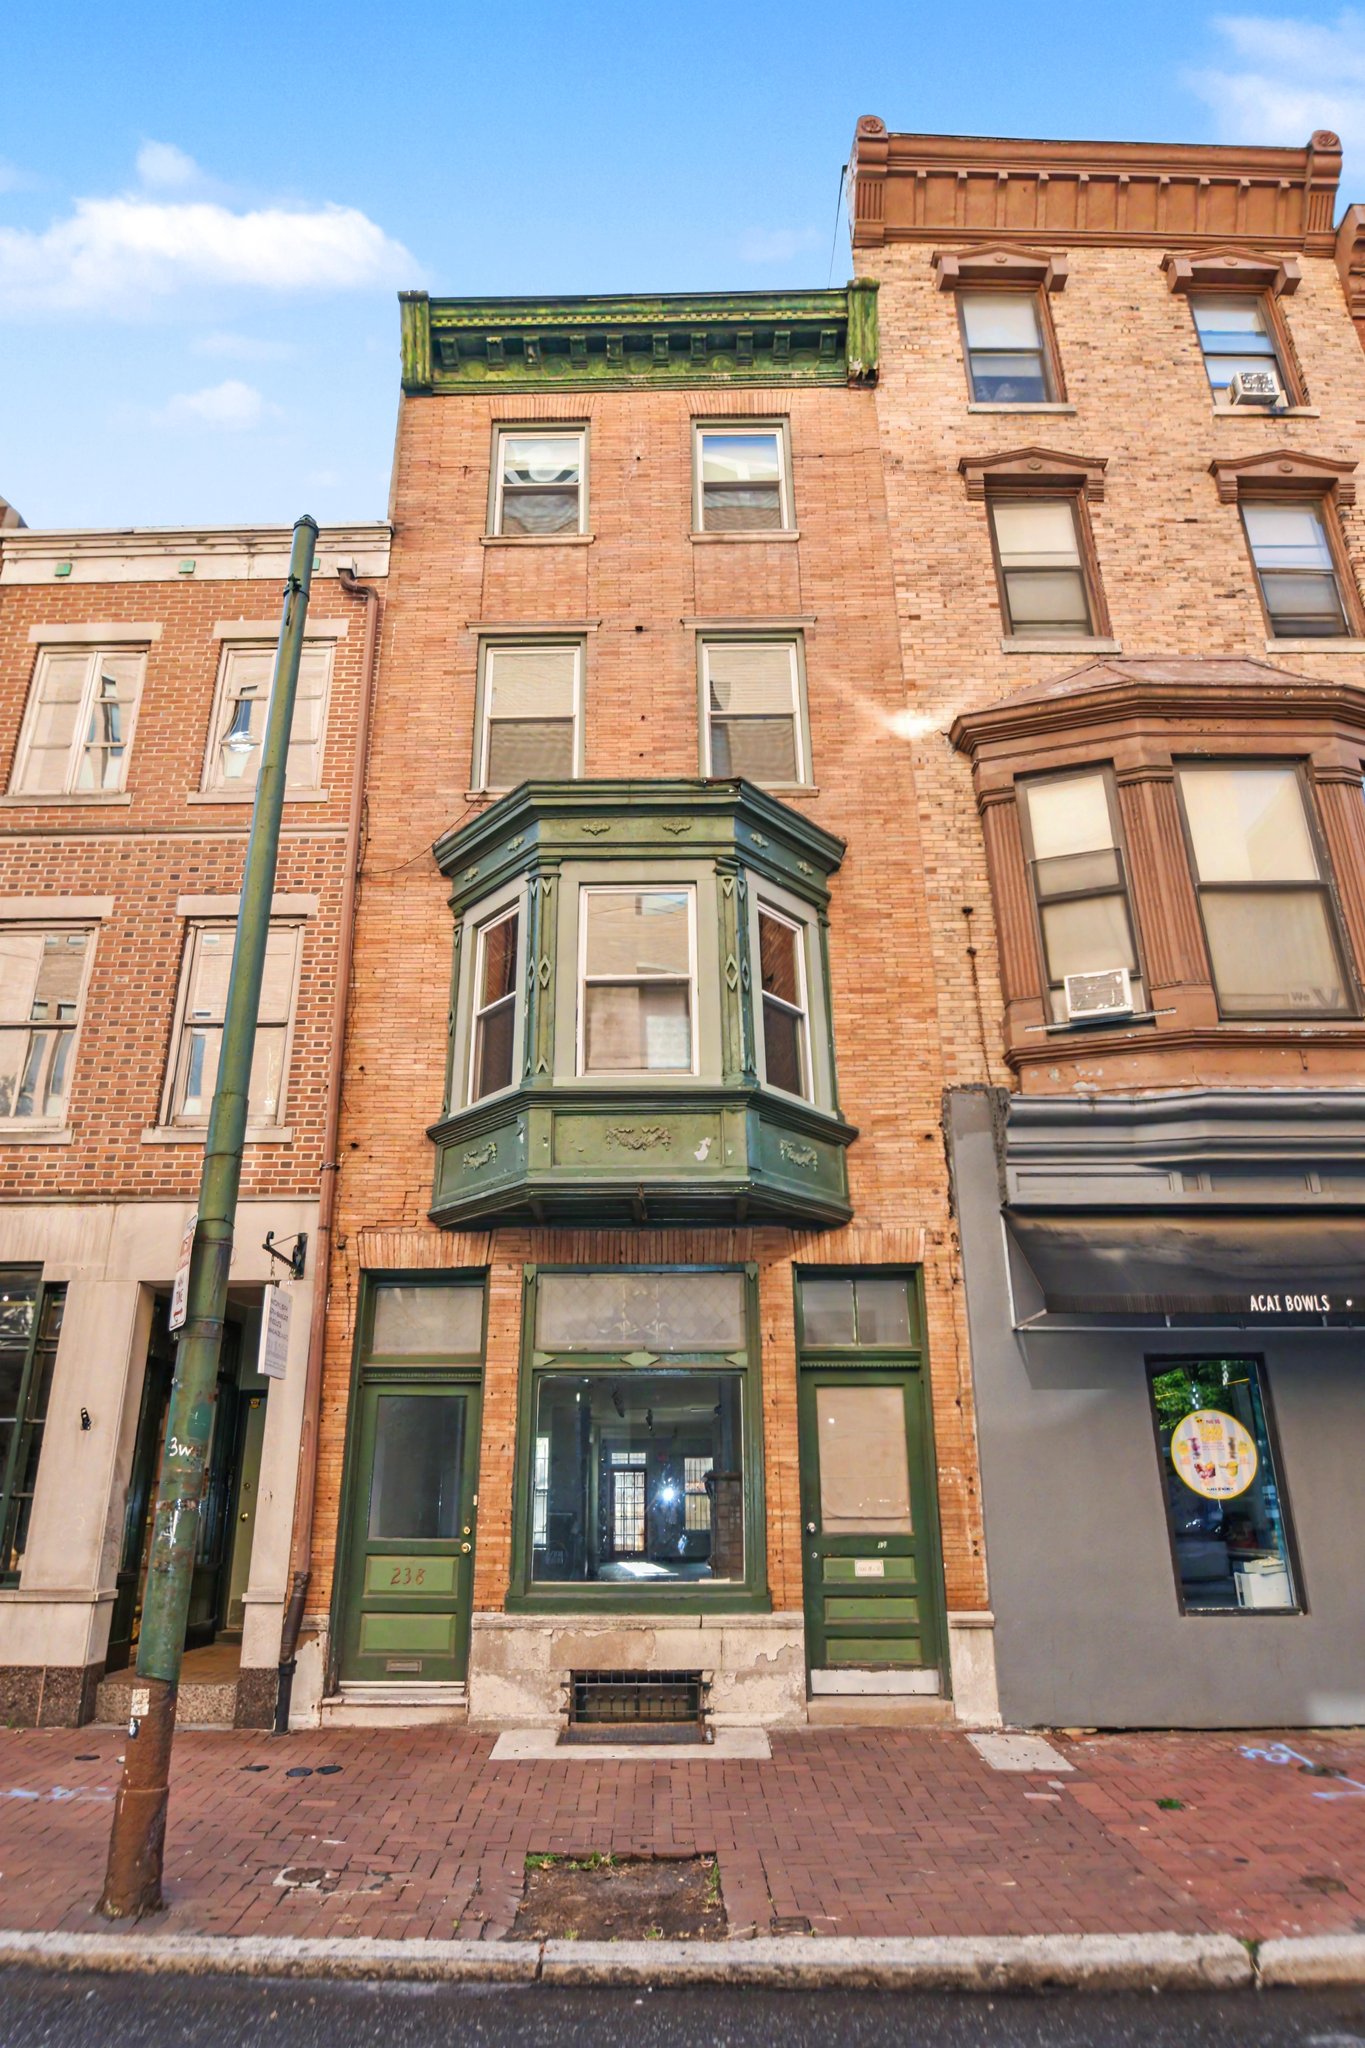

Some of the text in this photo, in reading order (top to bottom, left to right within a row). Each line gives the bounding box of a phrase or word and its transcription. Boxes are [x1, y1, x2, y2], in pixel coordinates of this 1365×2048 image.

[1250, 1294, 1330, 1312] ACAI BOWLS
[390, 1567, 427, 1586] 238
